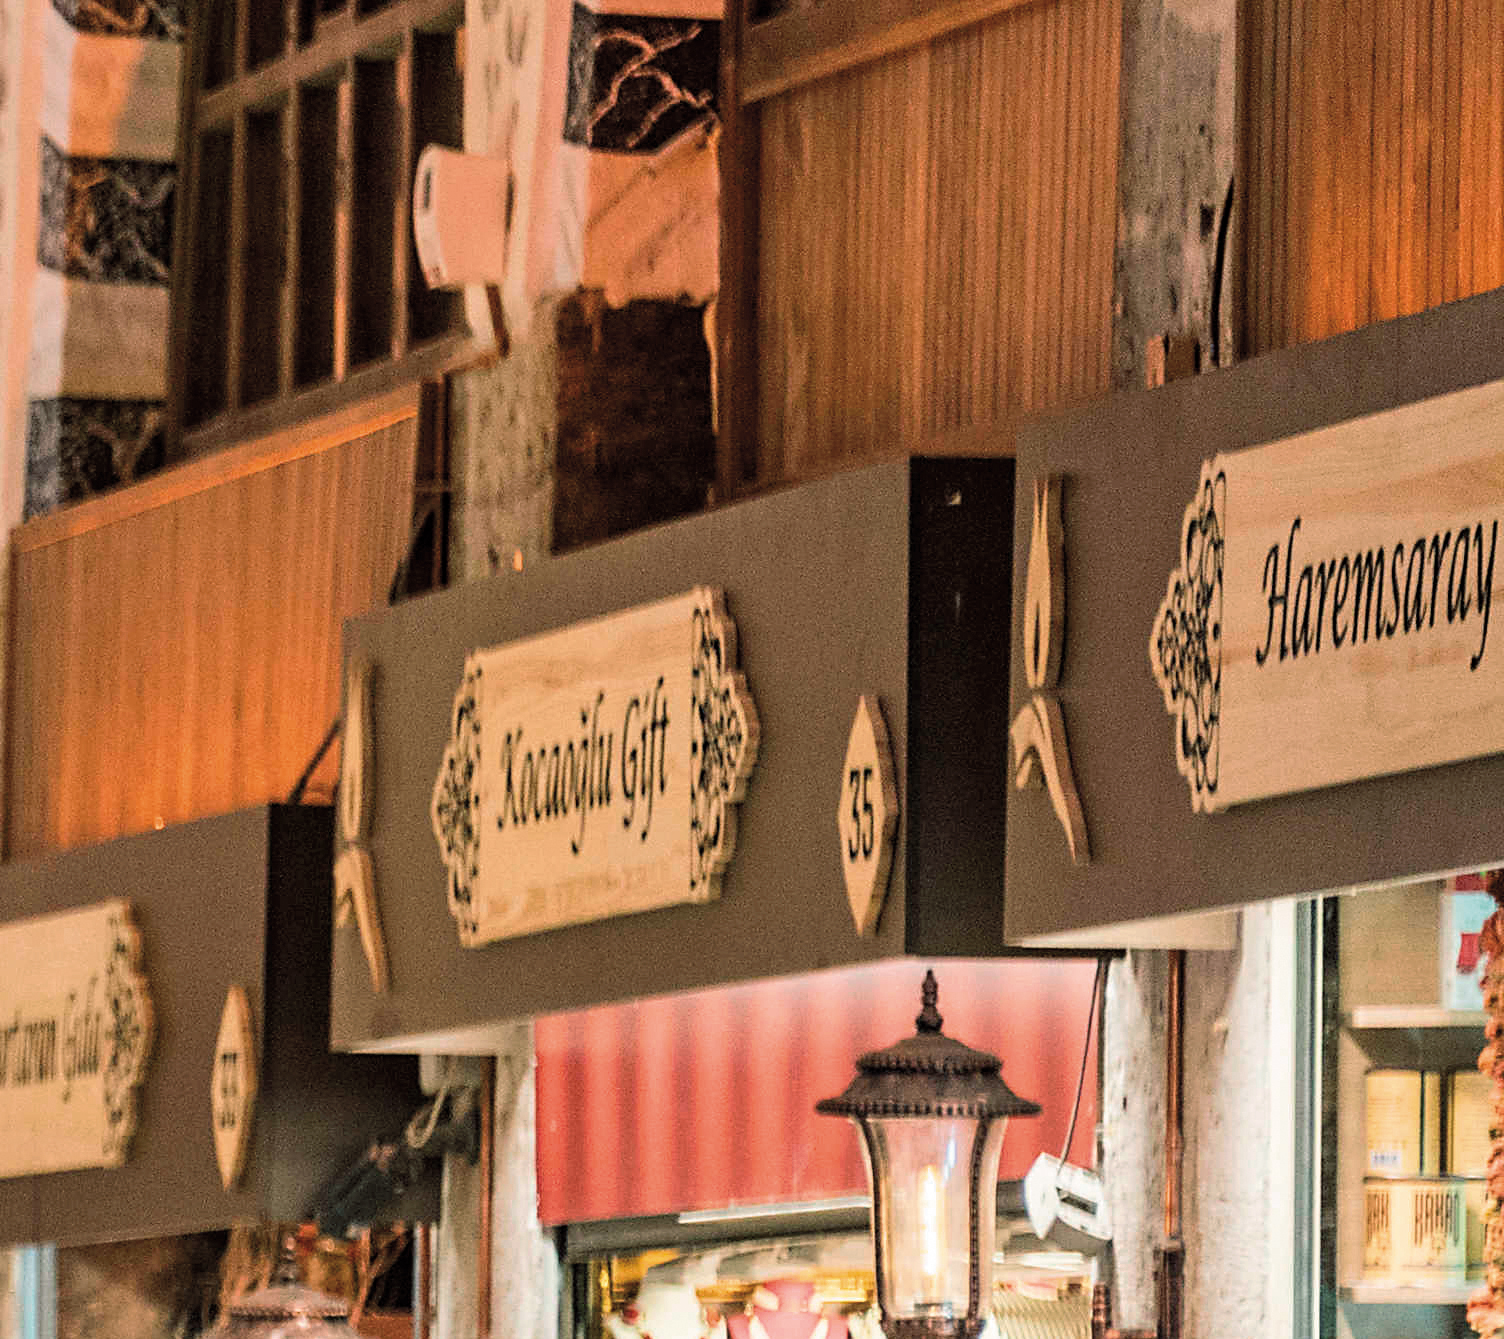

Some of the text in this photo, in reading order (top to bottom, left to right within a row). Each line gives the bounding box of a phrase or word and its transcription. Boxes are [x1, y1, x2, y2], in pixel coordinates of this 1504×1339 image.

[1255, 514, 1498, 672] Haremsaray
[496, 674, 670, 858] Kocaoğlu Gift
[848, 767, 874, 863] 35
